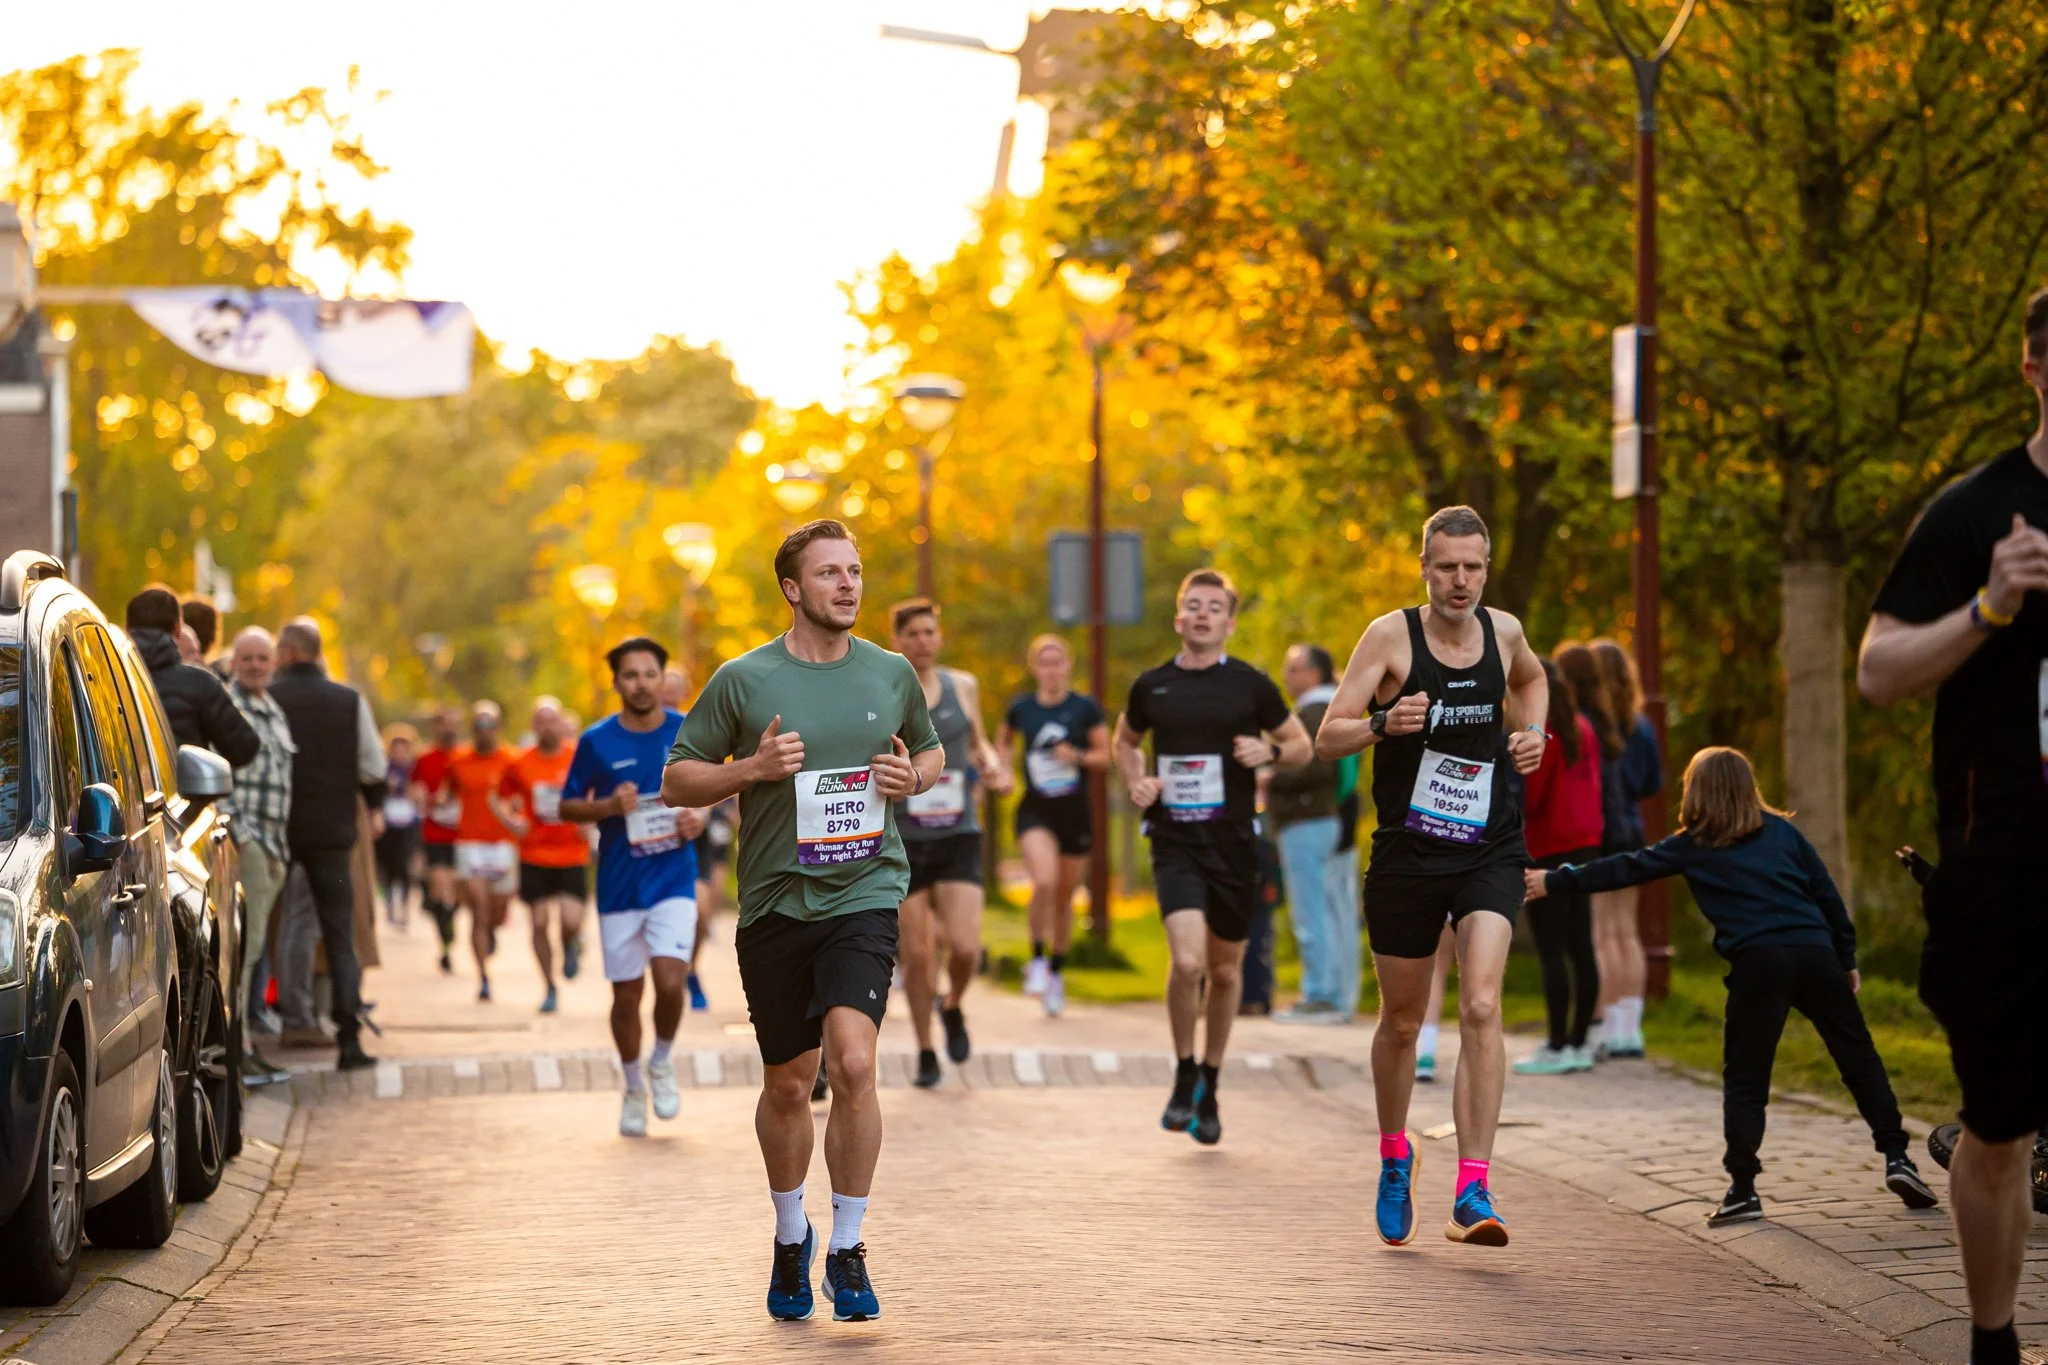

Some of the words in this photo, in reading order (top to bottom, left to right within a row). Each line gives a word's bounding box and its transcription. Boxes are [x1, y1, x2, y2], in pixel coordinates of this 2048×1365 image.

[1444, 707, 1454, 717] SV
[1455, 704, 1494, 717] SPORTLUST
[819, 776, 842, 785] ALL
[1429, 780, 1479, 801] RAMONA
[825, 801, 865, 815] HERO
[1434, 798, 1468, 815] 10549
[827, 818, 860, 834] 8790
[814, 843, 844, 852] Alkmaar
[846, 841, 860, 850] City
[861, 840, 875, 848] Run
[819, 852, 830, 862] by
[832, 851, 852, 861] night
